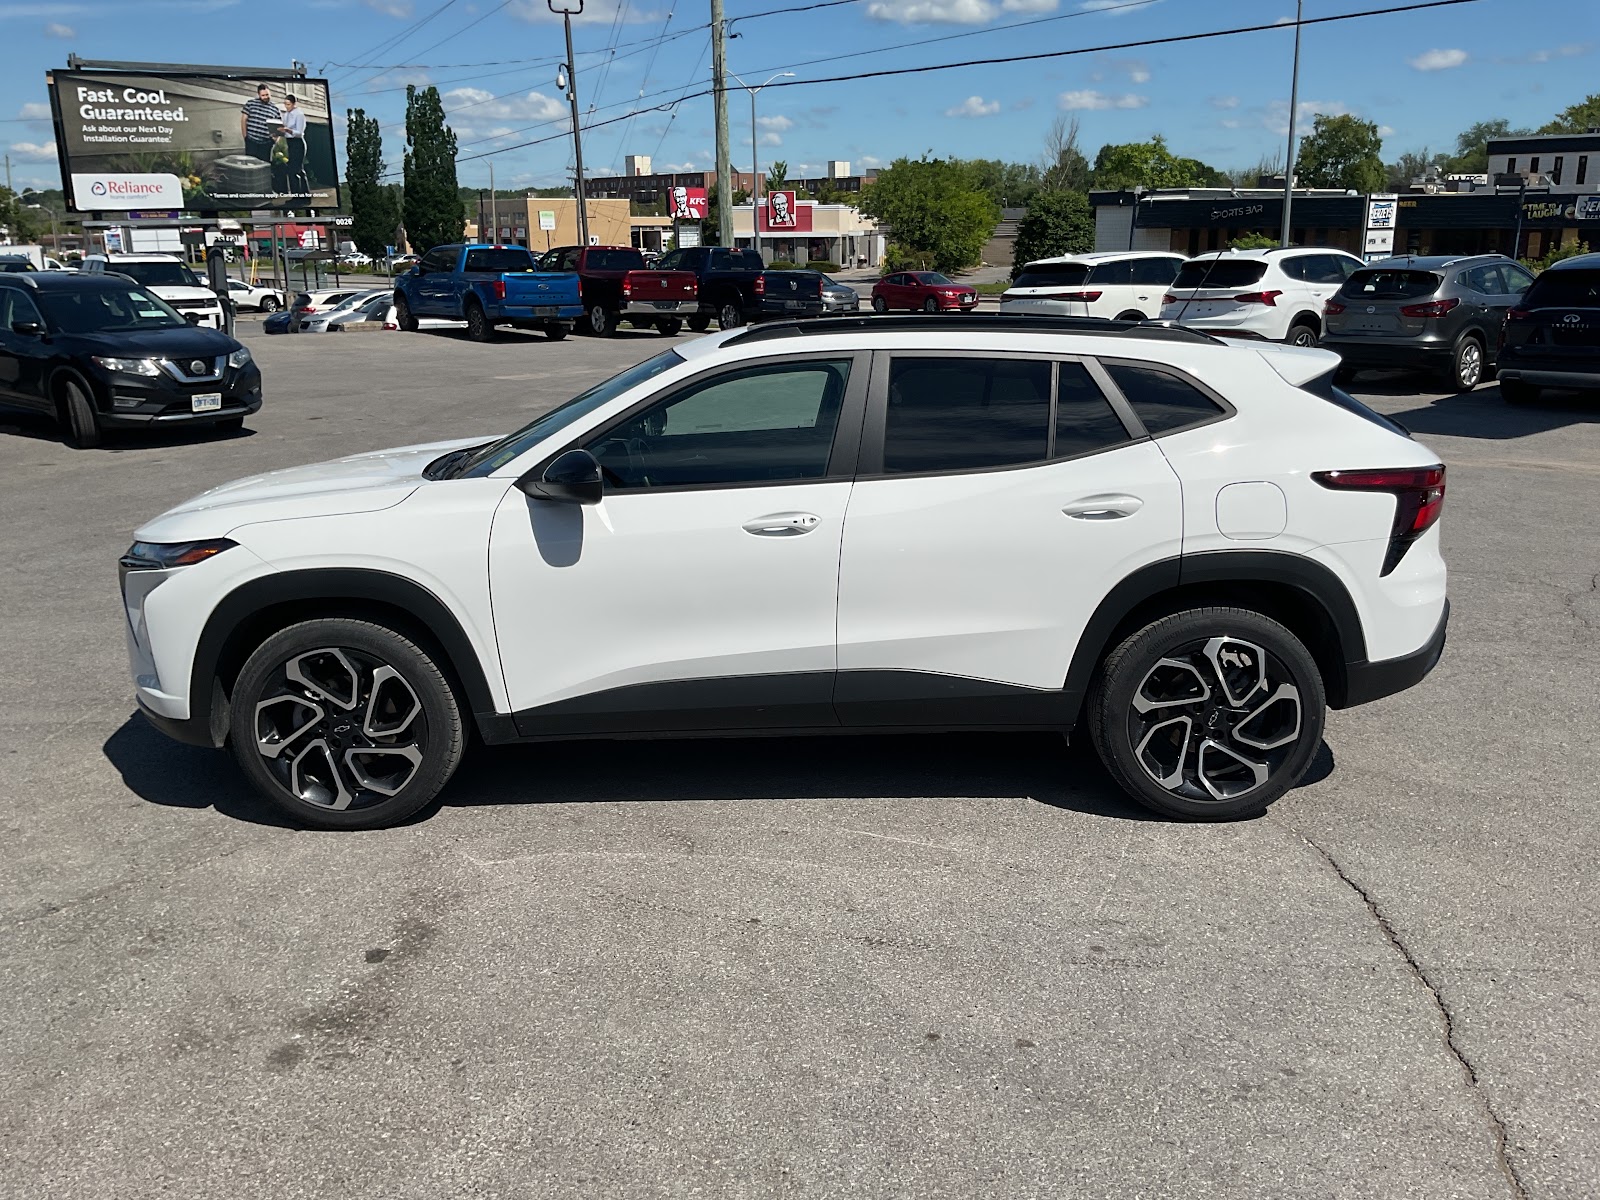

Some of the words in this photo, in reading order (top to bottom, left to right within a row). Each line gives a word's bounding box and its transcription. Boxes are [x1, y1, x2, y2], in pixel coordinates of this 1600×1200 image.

[77, 86, 119, 103] Fast.
[123, 88, 170, 104] Cool.
[80, 104, 189, 121] Guaranteed.
[82, 124, 97, 132] Ask
[98, 125, 122, 133] about
[158, 126, 174, 135] Day
[83, 135, 128, 143] Installation
[108, 181, 163, 194] Reliance
[689, 197, 706, 205] KFC
[1211, 207, 1244, 220] SPORTS
[1245, 205, 1264, 215] BAR
[1527, 208, 1556, 219] LAUGH
[335, 218, 353, 226] 0026
[214, 234, 240, 243] astral
